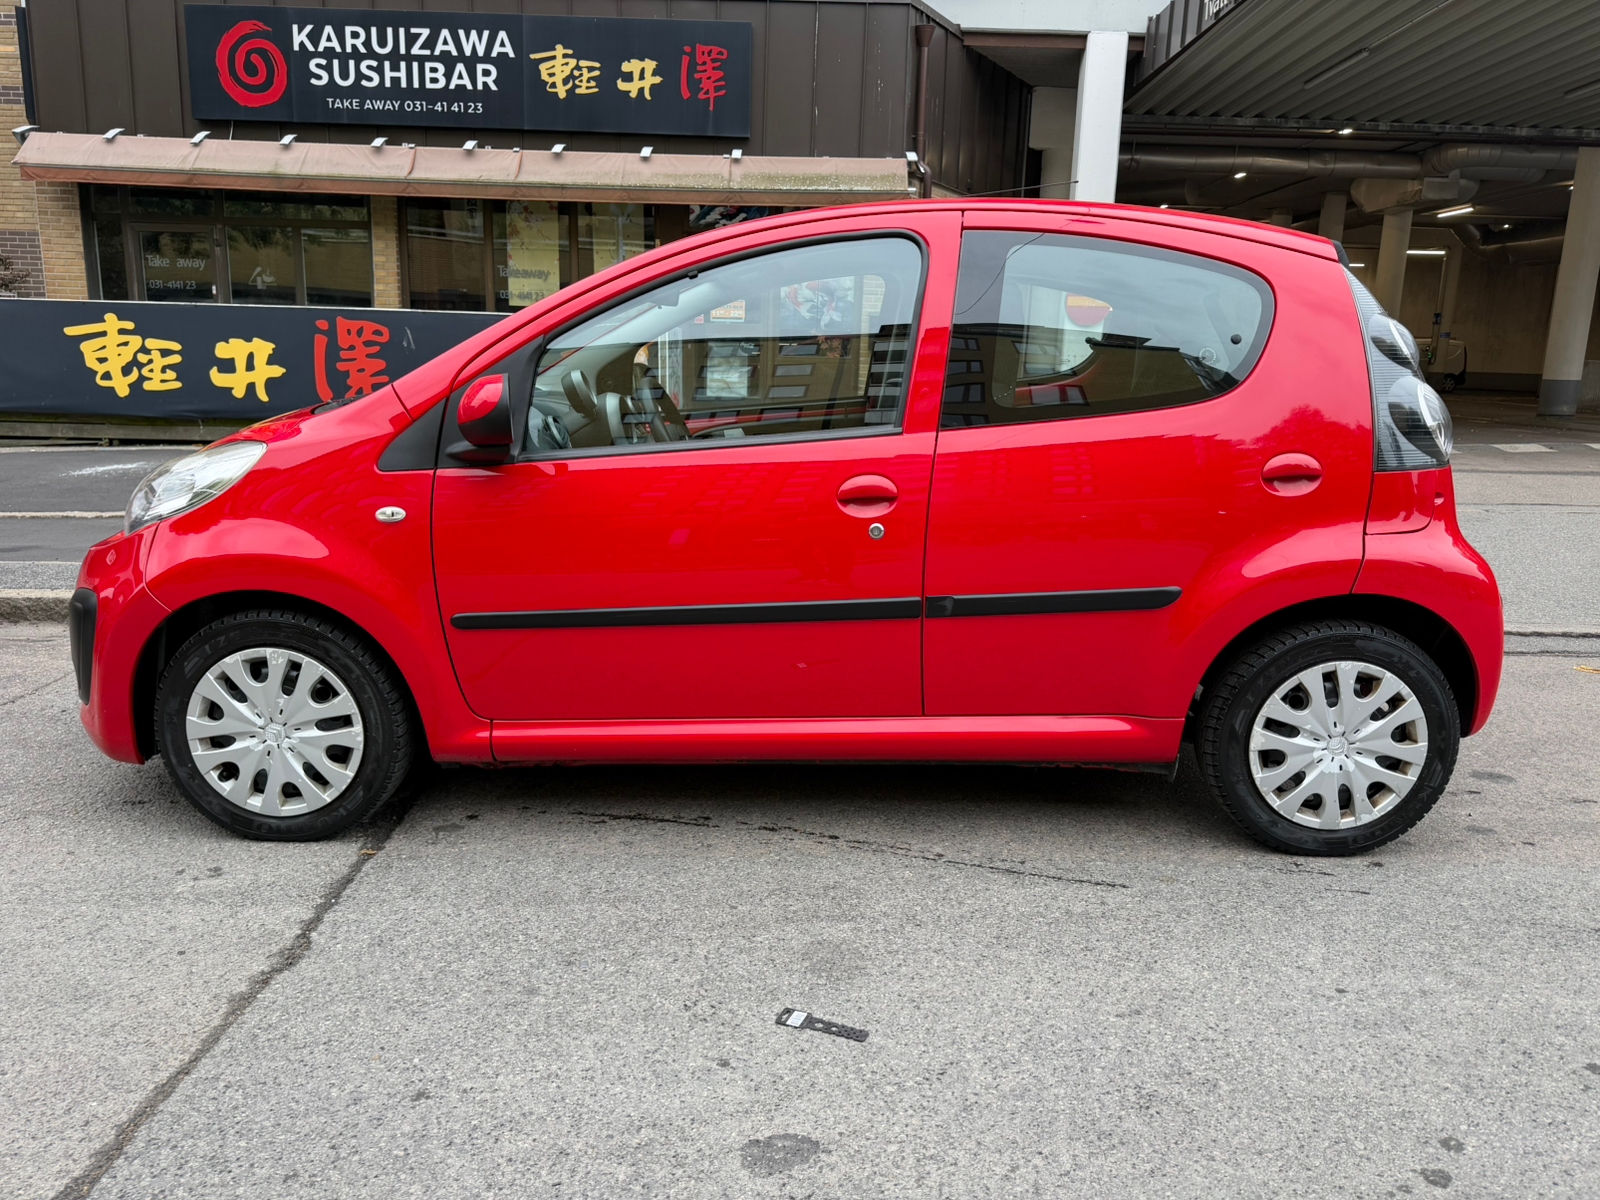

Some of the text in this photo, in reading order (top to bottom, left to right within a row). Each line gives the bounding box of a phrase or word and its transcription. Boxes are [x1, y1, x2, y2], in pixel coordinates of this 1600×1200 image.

[292, 24, 516, 58] KARUIZAWA
[309, 58, 499, 91] SUSHIBAR
[327, 98, 483, 114] TAKE AWAY 031-41 41 23
[146, 255, 206, 271] Take away
[186, 281, 197, 289] 23
